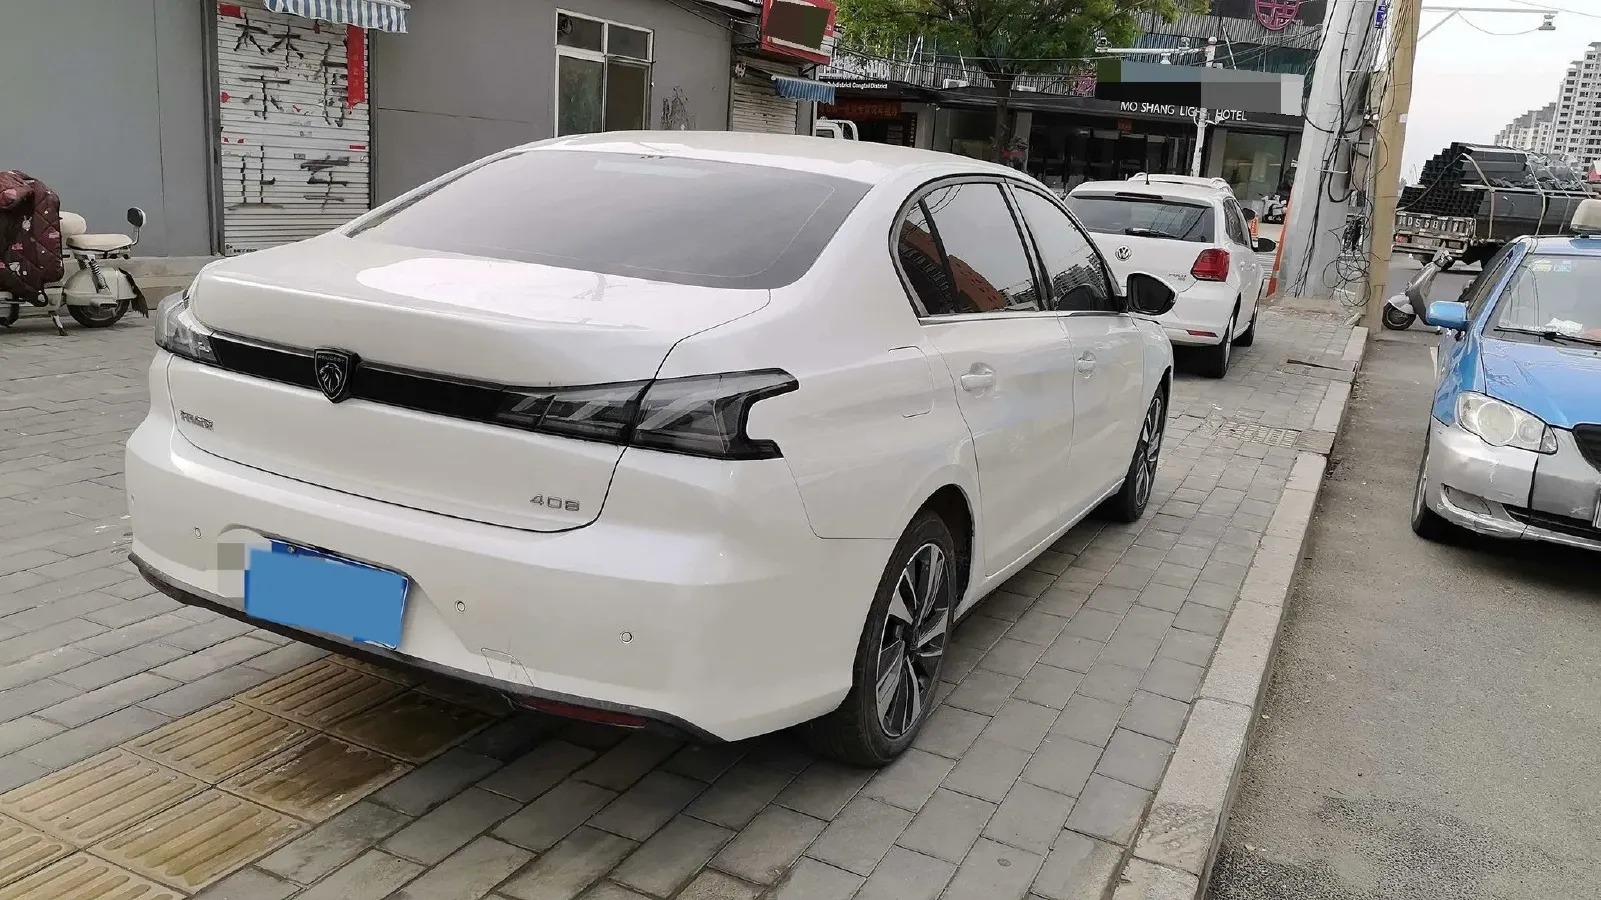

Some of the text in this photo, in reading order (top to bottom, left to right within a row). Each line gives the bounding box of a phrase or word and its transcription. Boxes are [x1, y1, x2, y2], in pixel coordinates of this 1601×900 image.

[1120, 101, 1138, 112] MO
[1140, 103, 1175, 115] SHANG
[1216, 109, 1248, 121] HOTEL
[530, 494, 580, 511] 408
